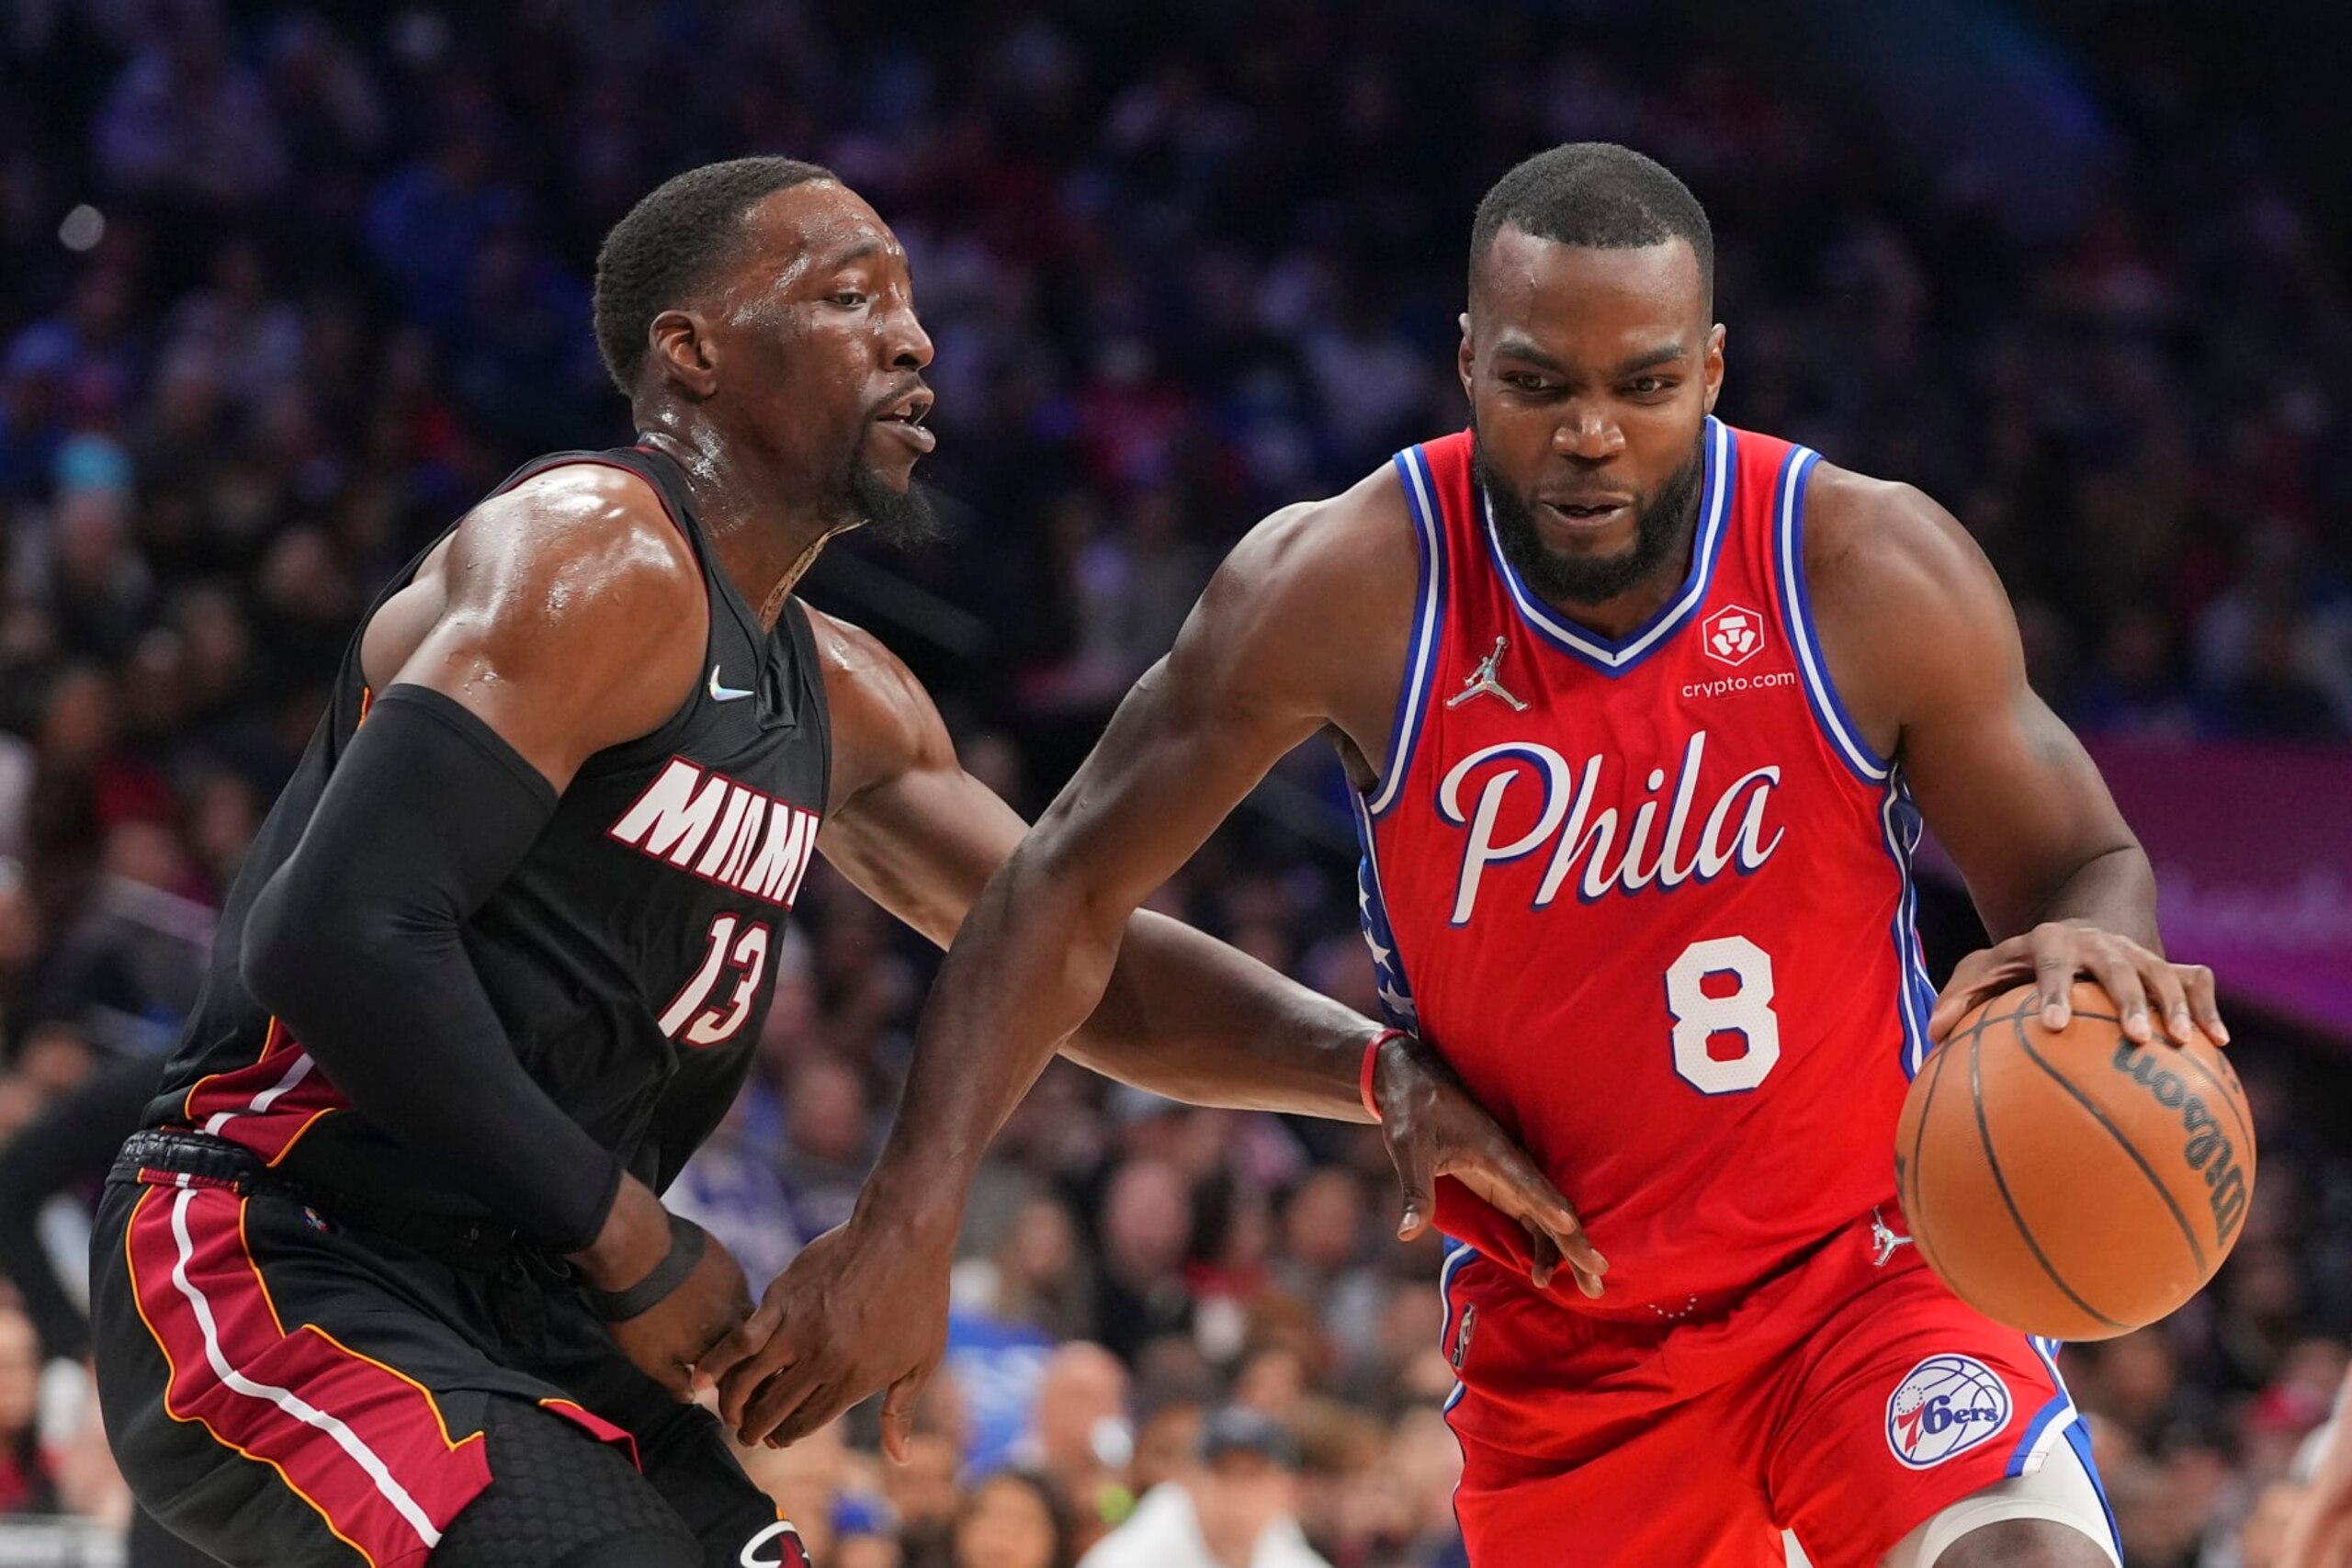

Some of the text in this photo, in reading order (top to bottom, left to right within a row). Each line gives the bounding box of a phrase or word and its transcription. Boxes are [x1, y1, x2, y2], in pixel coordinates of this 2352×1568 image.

[1682, 671, 1796, 698] crypto.com
[606, 754, 820, 910] MIAMI
[1436, 731, 1784, 927] Phila
[658, 913, 770, 1047] 13
[1664, 934, 1781, 1096] 8
[2112, 1035, 2246, 1248] Wilson
[1897, 1394, 1999, 1453] 76ers
